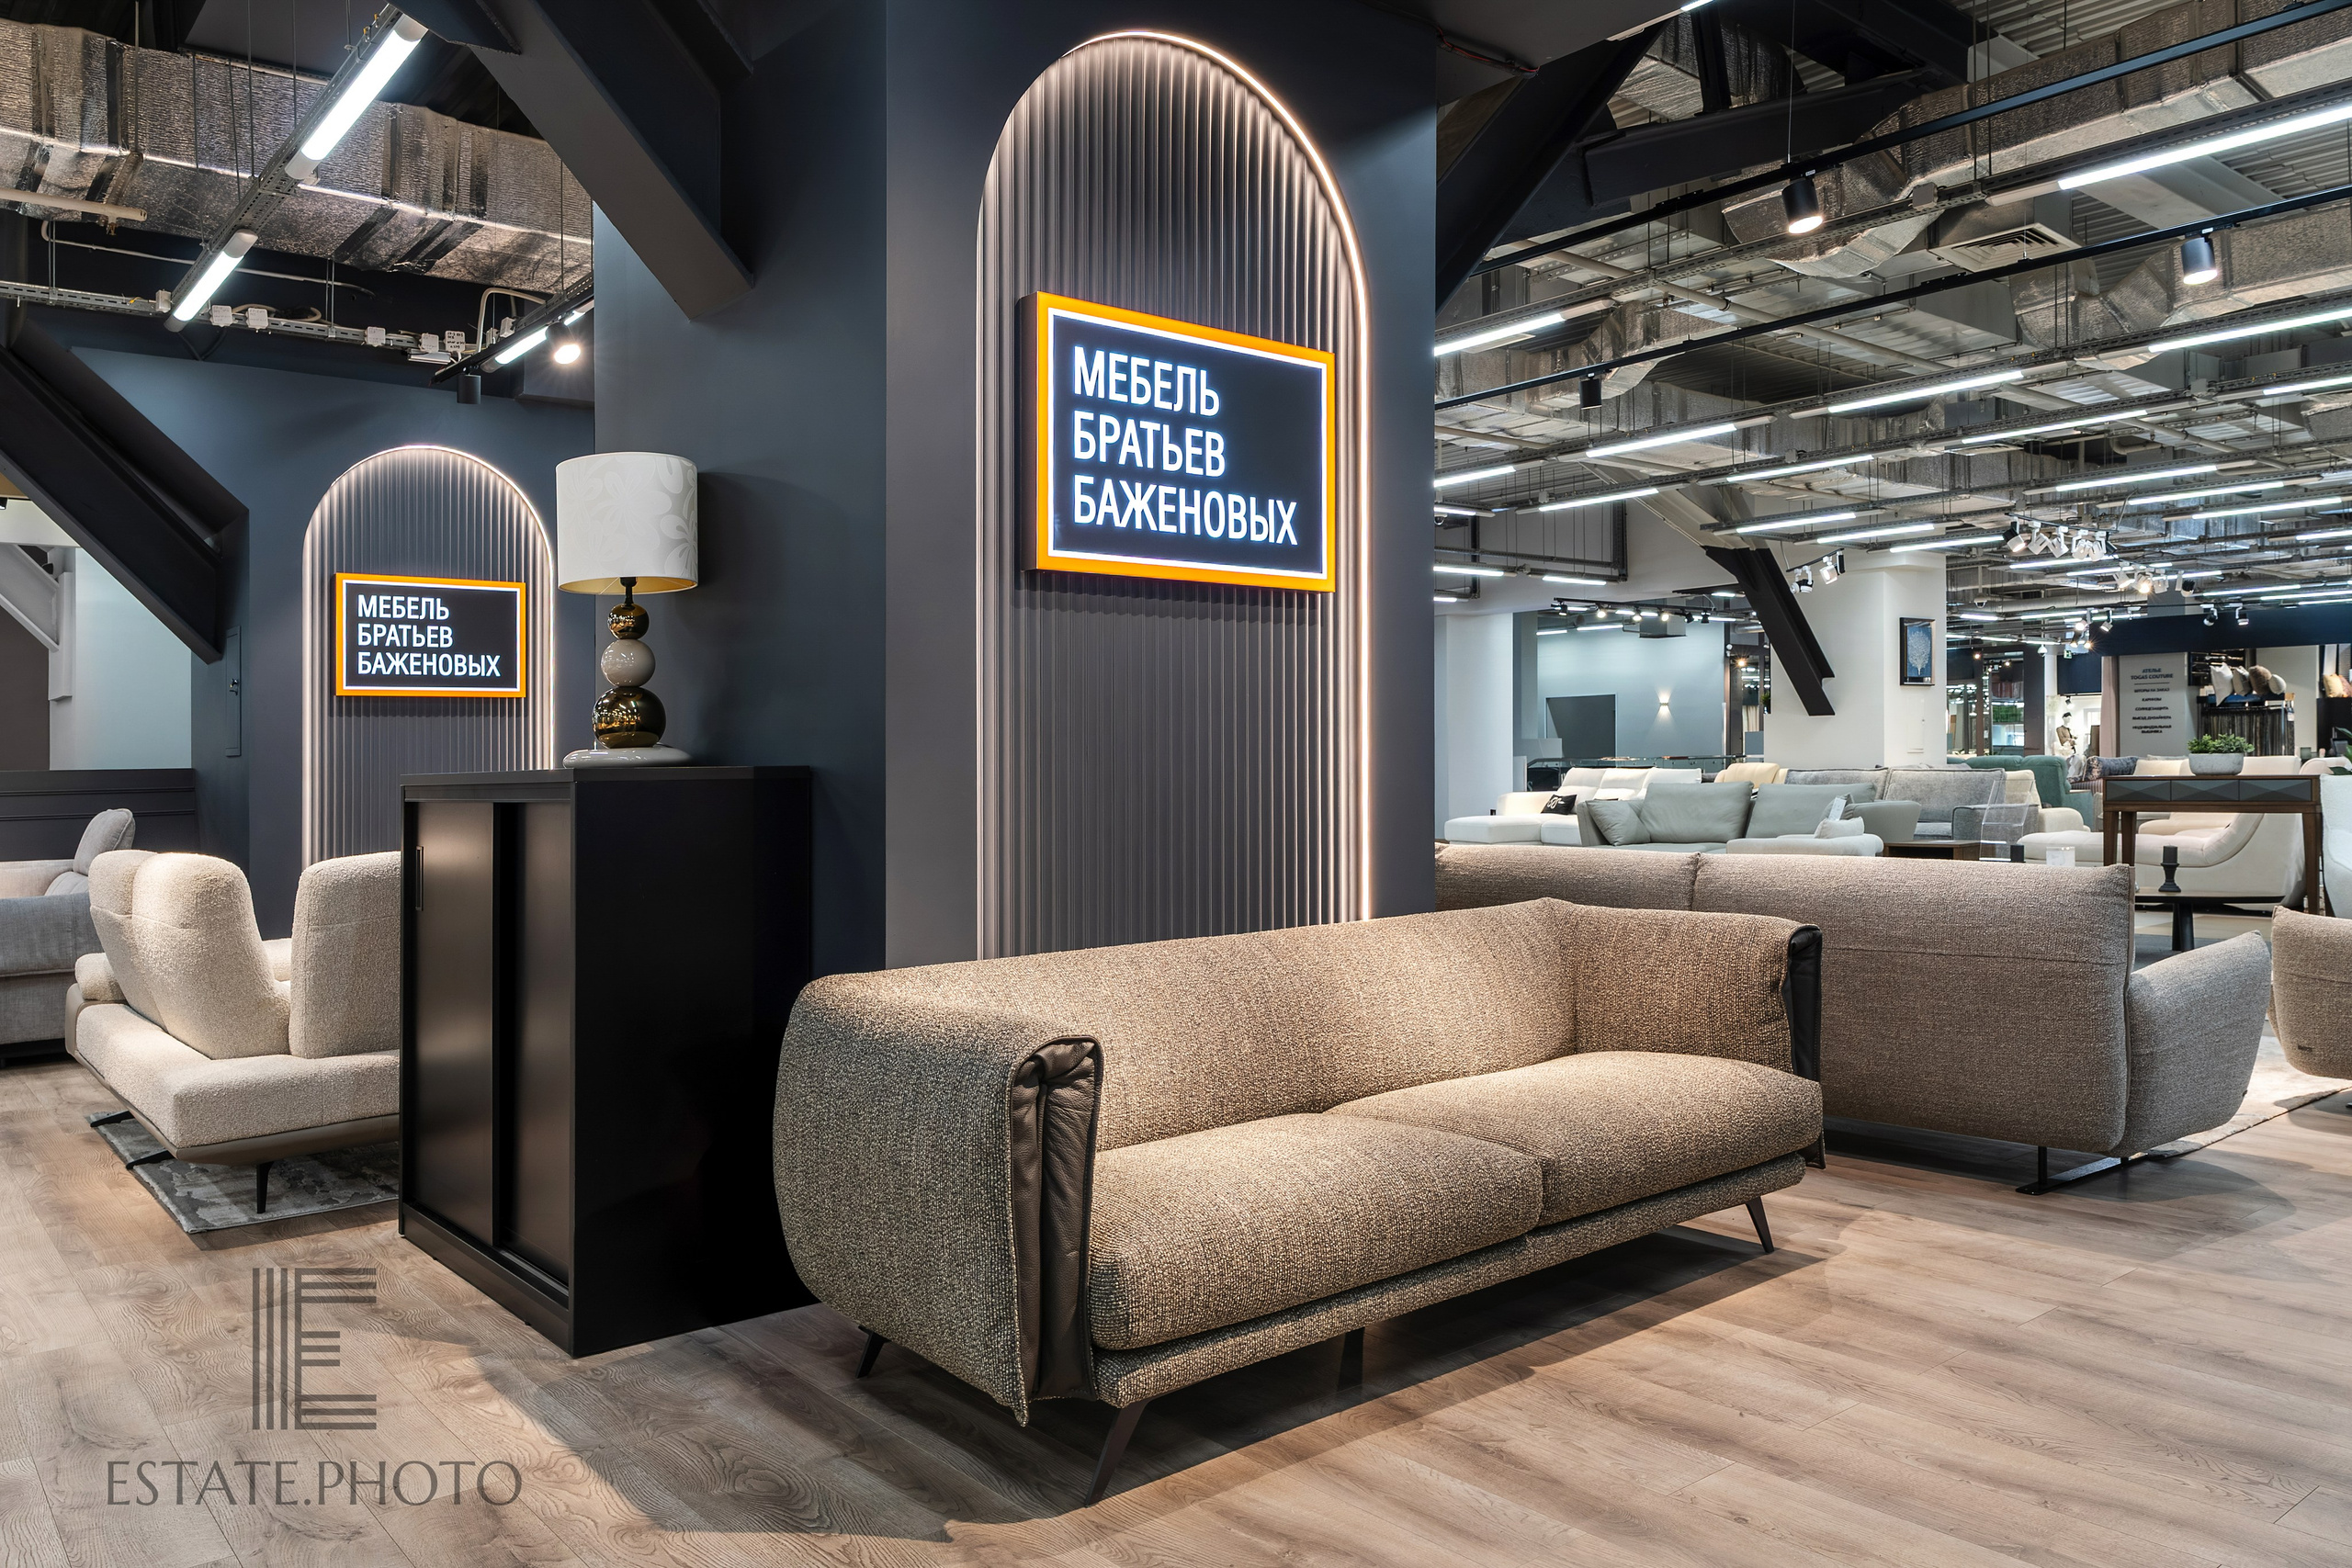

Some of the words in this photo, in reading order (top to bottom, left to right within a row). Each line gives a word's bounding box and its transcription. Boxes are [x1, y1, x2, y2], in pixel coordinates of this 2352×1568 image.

[1073, 345, 1221, 416] МЕБЕЛЬ
[1073, 410, 1226, 478] БРАТЬЕВ
[1073, 474, 1298, 546] БАЖЕНОВЫХ
[357, 594, 450, 620] МЕБЕЛЬ
[357, 623, 453, 649] БРАТЬЕВ
[357, 651, 501, 677] БАЖЕНОВЫХ
